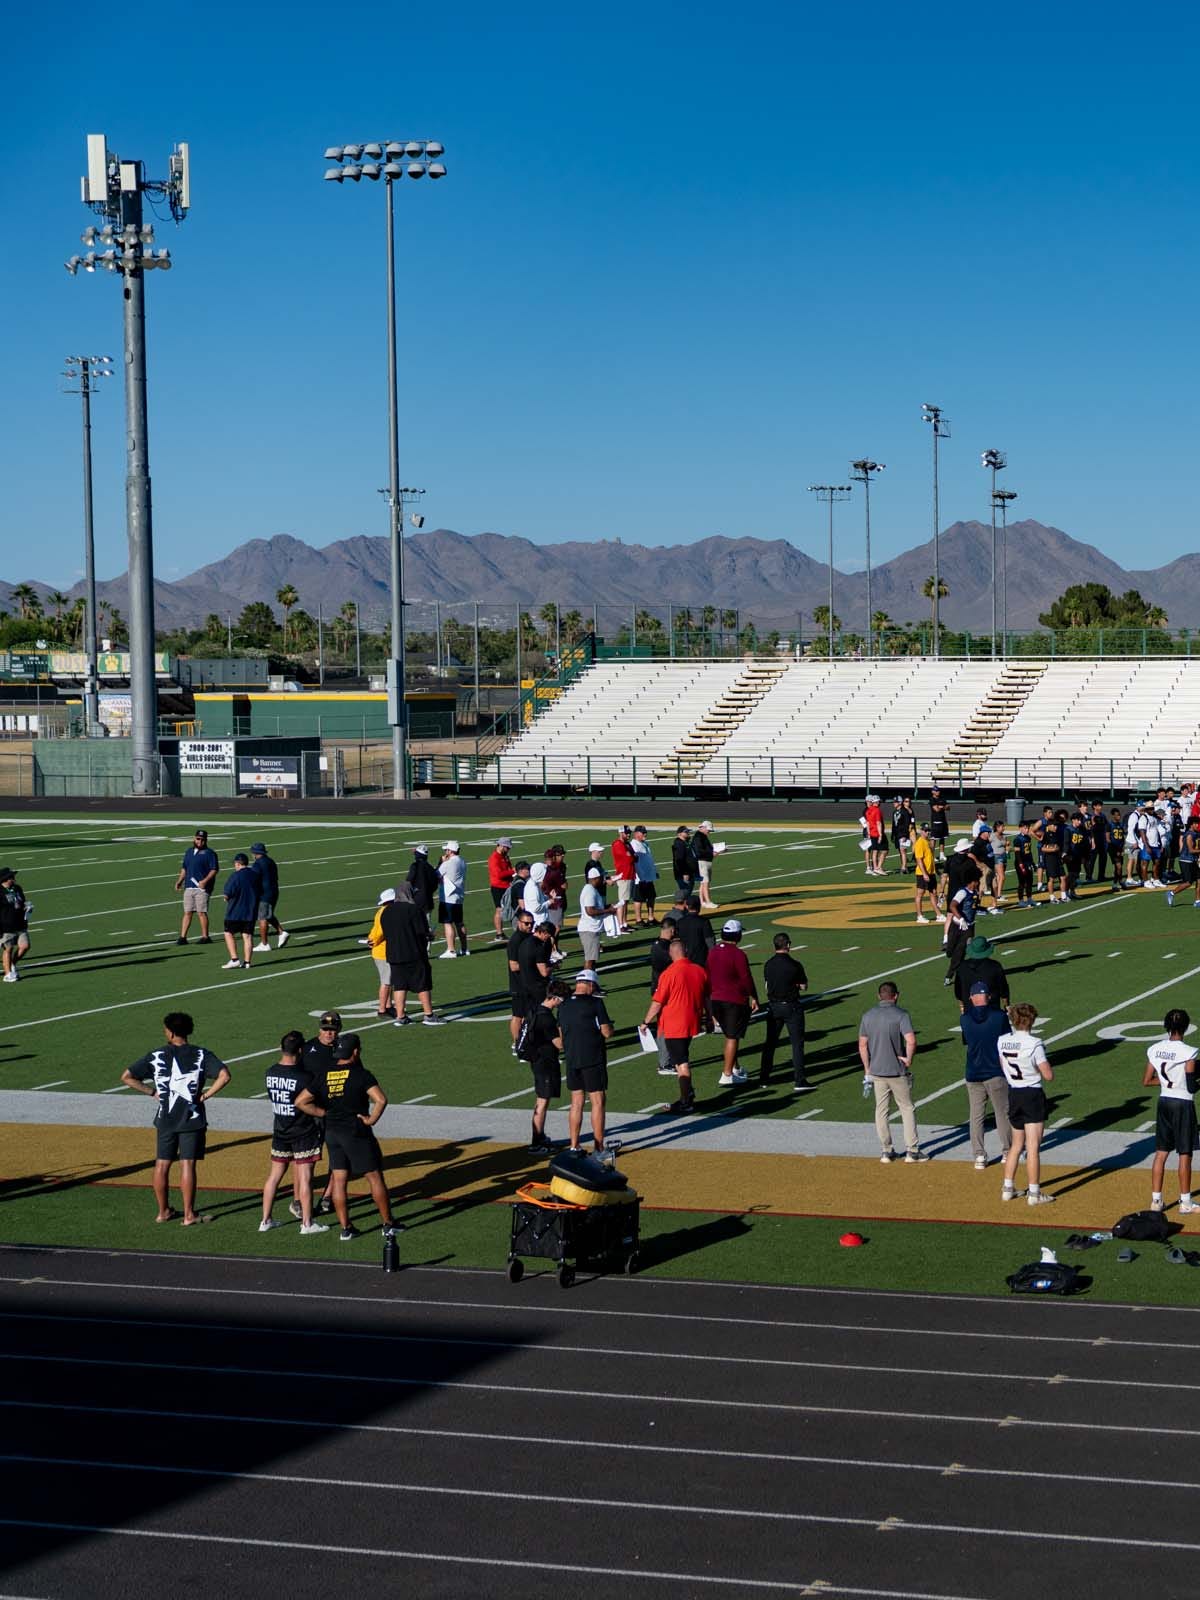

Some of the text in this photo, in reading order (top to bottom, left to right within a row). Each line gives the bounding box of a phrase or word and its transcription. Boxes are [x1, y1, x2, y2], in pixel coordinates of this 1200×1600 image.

[189, 744, 222, 752] 2000-2001
[186, 754, 226, 762] GIRLS SOCCER
[1155, 1050, 1177, 1061] SAGUARO
[1002, 1051, 1024, 1081] 5
[1160, 1062, 1173, 1089] 1
[266, 1076, 297, 1091] BRING
[270, 1089, 290, 1102] THE
